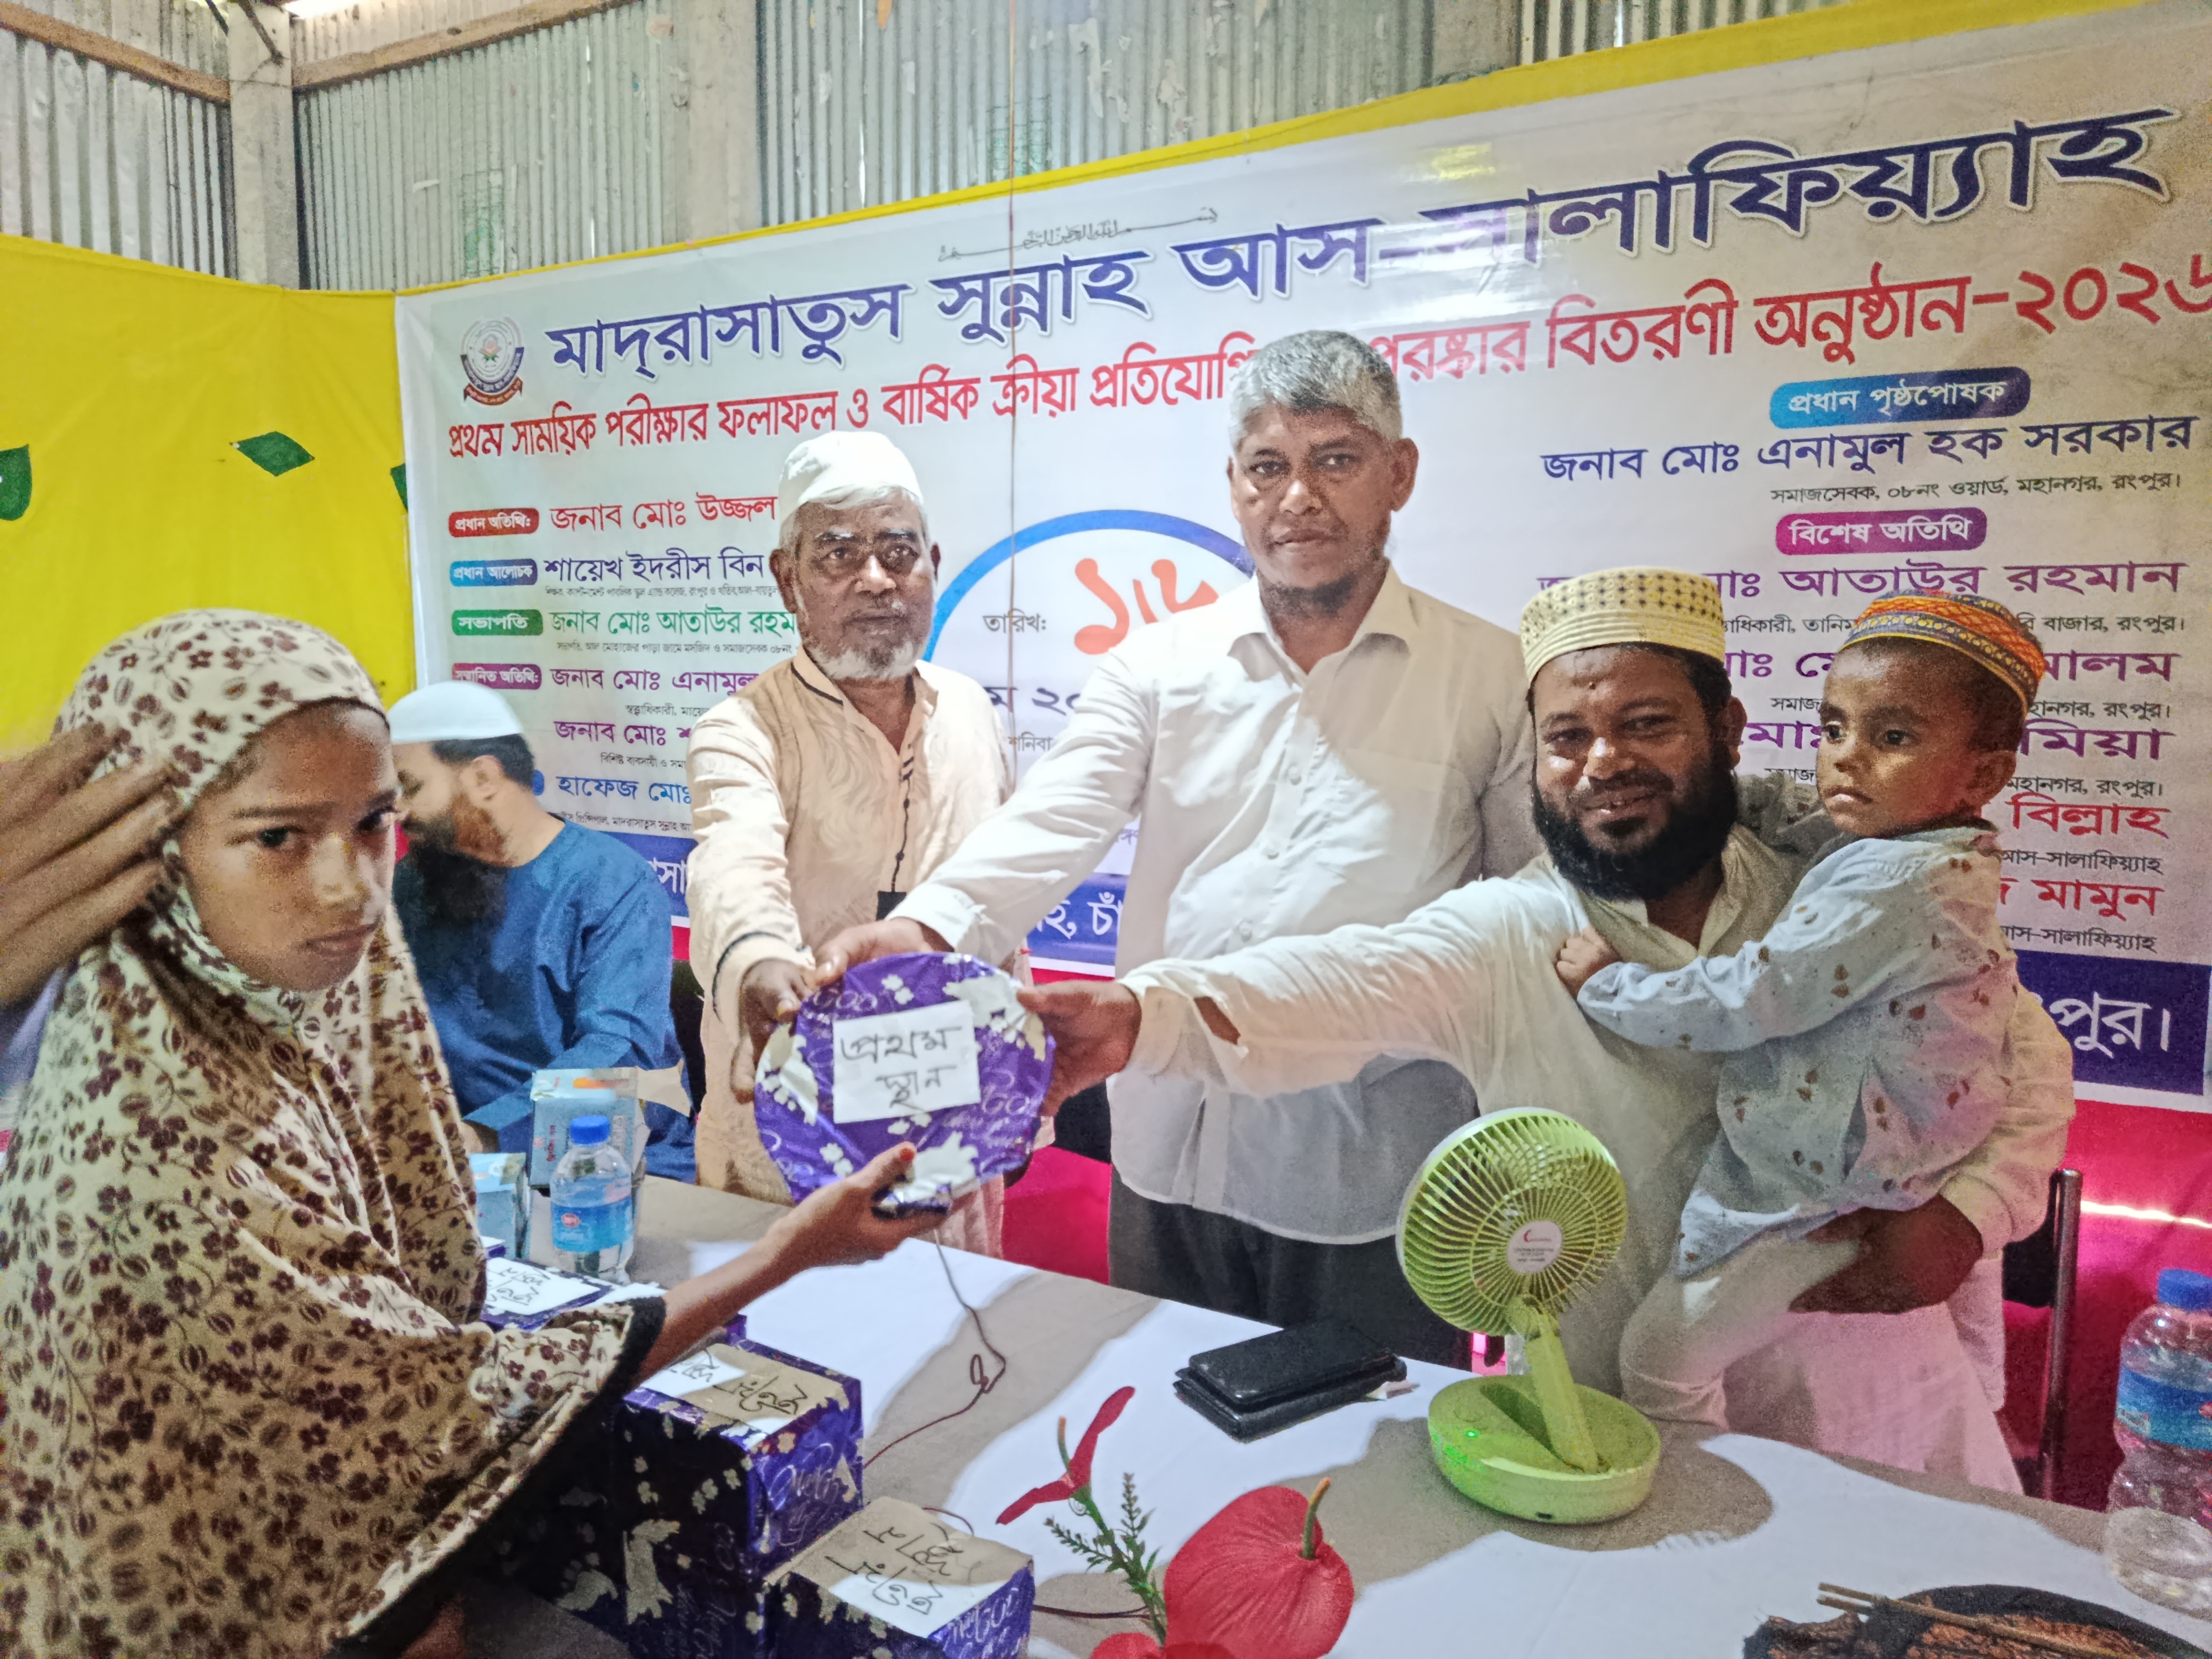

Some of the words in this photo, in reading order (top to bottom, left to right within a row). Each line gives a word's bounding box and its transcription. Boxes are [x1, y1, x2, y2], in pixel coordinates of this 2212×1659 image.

[928, 251, 1151, 344] সুন্নাহ
[448, 422, 504, 458] প্রথম
[510, 401, 597, 456] সাময়িক
[606, 393, 709, 447] পরীক্ষার
[718, 390, 838, 439] ফলাফল
[847, 389, 868, 429] ও
[882, 363, 980, 425] বার্ষিক
[990, 353, 1079, 418] ক্রীয়া
[1546, 278, 1739, 369] বিতরণী
[1788, 389, 1860, 414] প্রধান
[1870, 379, 2007, 416] পৃষ্ঠপোষক
[1540, 447, 1648, 481] জনাব
[1662, 441, 1740, 475] মোঃ
[1757, 432, 1913, 474] এনামুল
[1924, 427, 2007, 463] হক
[2020, 415, 2200, 456] সরকার
[1771, 484, 1880, 503] সমাজসেবক,
[2017, 475, 2102, 494] মহানগর,
[2111, 473, 2180, 491] রংপুর।
[455, 518, 486, 531] প্রধান
[549, 504, 623, 531] জনাব
[633, 499, 686, 530] মোঃ
[1788, 521, 1871, 545] বিশেষ
[1880, 515, 1973, 544] অতিথি
[453, 566, 484, 580] প্রধান
[486, 565, 533, 579] আলোচক
[544, 557, 623, 583] শায়েখ
[626, 547, 711, 583] ইদরীস
[719, 546, 764, 579] বিন
[1779, 559, 1987, 596] আতাউর
[2003, 561, 2188, 595] রহমান
[458, 614, 529, 630] সভাপতি
[549, 610, 601, 634] জনাব
[608, 610, 650, 634] মোঃ
[656, 603, 742, 634] আতাউর
[748, 612, 795, 638] রহম
[2116, 615, 2184, 634] রংপুর।
[550, 667, 604, 690] জনাব
[613, 670, 660, 691] মোঃ
[2028, 700, 2095, 717] হানগর,
[2103, 701, 2170, 720] রংপুর।
[554, 721, 615, 743] জনাব
[624, 724, 666, 746] মোঃ
[1008, 732, 1053, 752] শনিবা
[670, 760, 686, 770] সমা
[556, 776, 639, 800] হাফেজ
[2096, 779, 2163, 798] রংপুর।
[2005, 791, 2171, 839] বিল্লাহ
[2031, 879, 2165, 922] মামুন
[840, 1026, 963, 1063] প্রথম
[875, 1065, 958, 1112] স্থান
